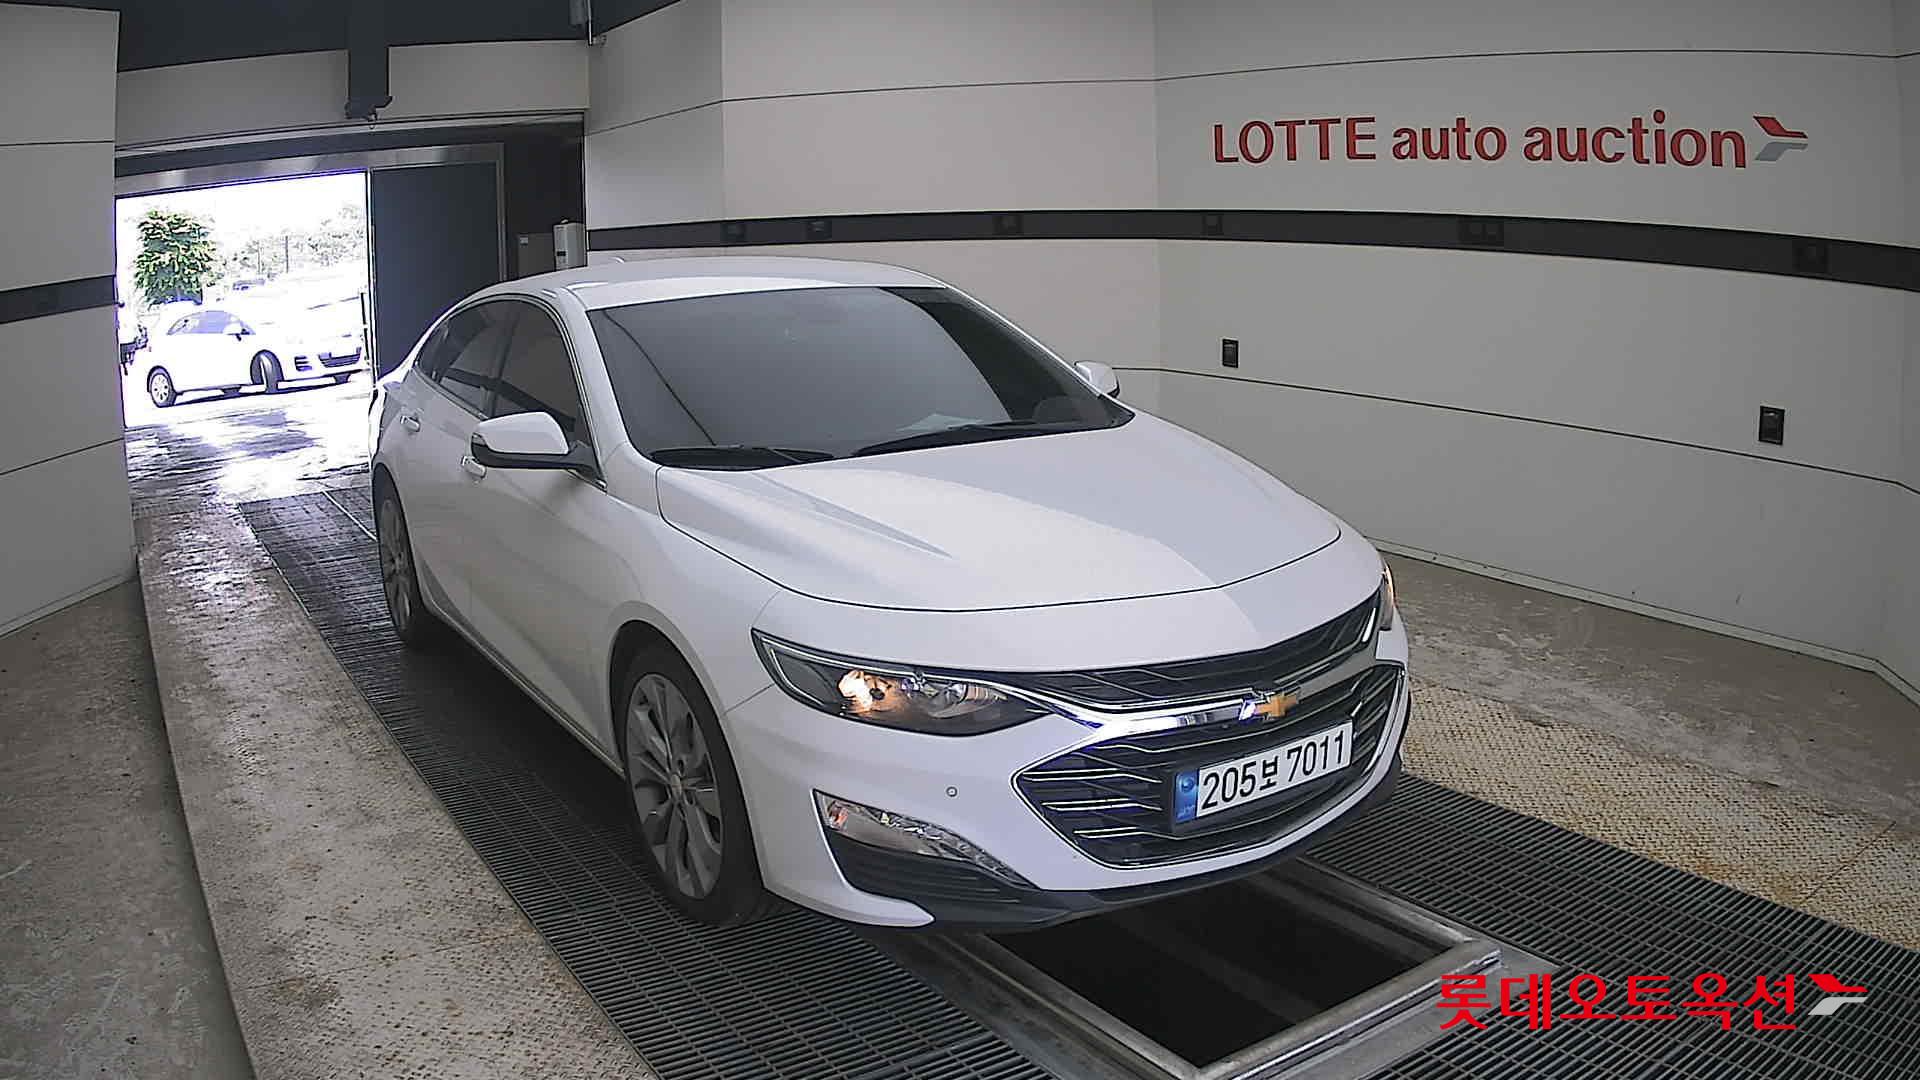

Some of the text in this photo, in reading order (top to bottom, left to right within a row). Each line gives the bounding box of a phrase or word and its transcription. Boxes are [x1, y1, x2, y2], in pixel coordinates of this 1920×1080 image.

[1213, 109, 1746, 168] LOTTE auto auction
[1286, 730, 1345, 782] 7011
